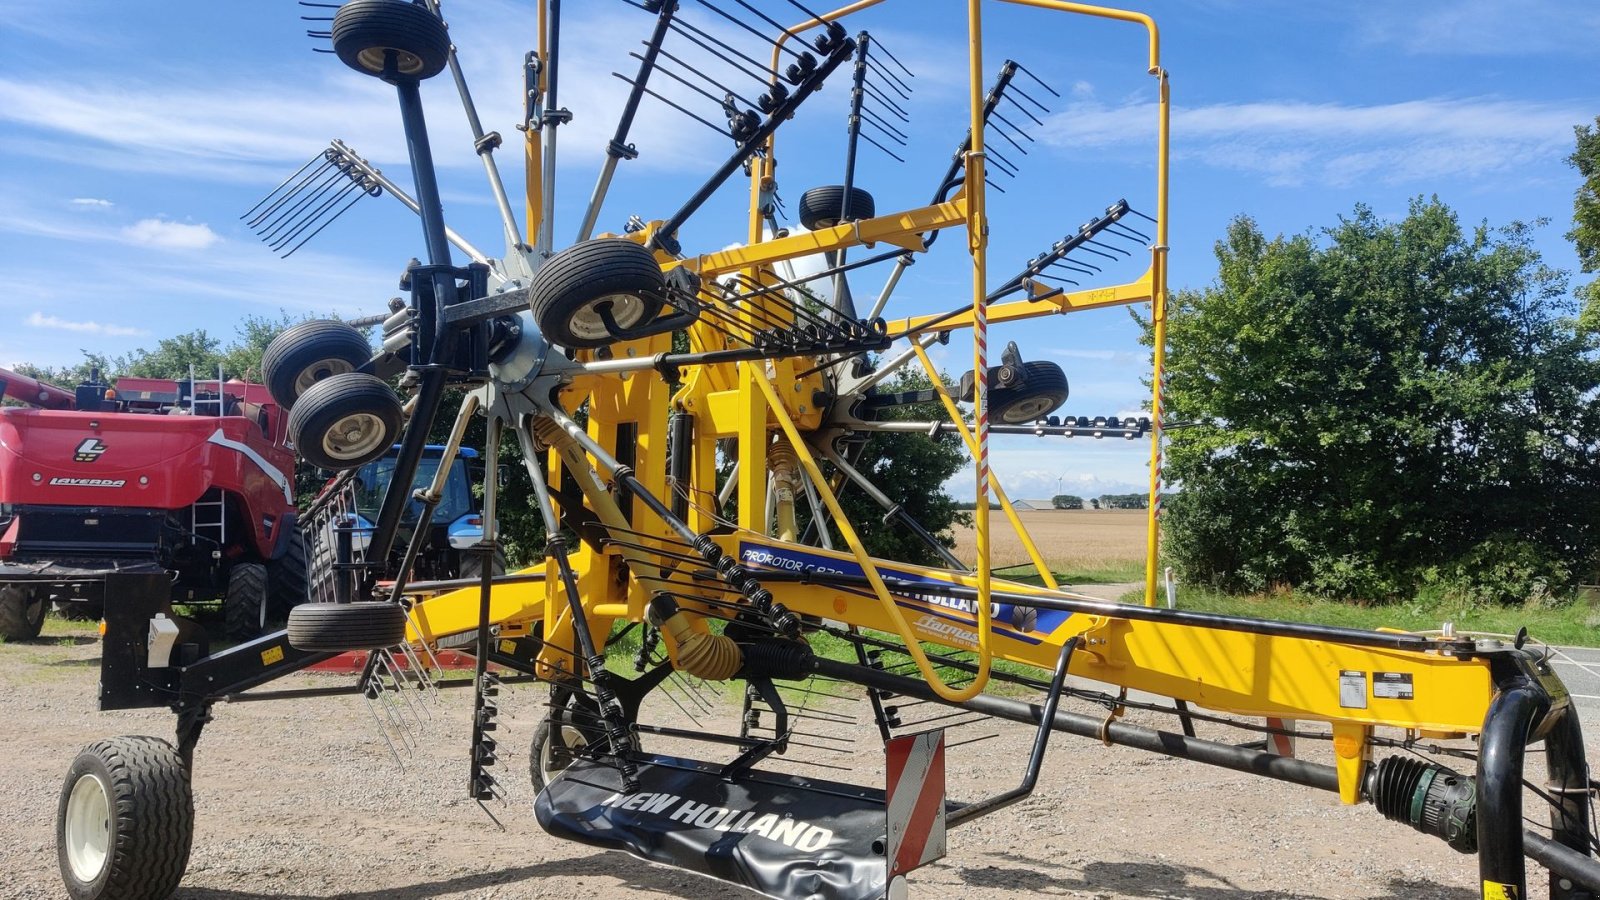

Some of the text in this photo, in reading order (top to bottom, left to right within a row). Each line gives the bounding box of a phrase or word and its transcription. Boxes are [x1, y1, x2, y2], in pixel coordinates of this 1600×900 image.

[49, 477, 127, 488] LAVERDA
[742, 549, 804, 571] PROROTOR
[669, 799, 834, 853] HOLLAND
